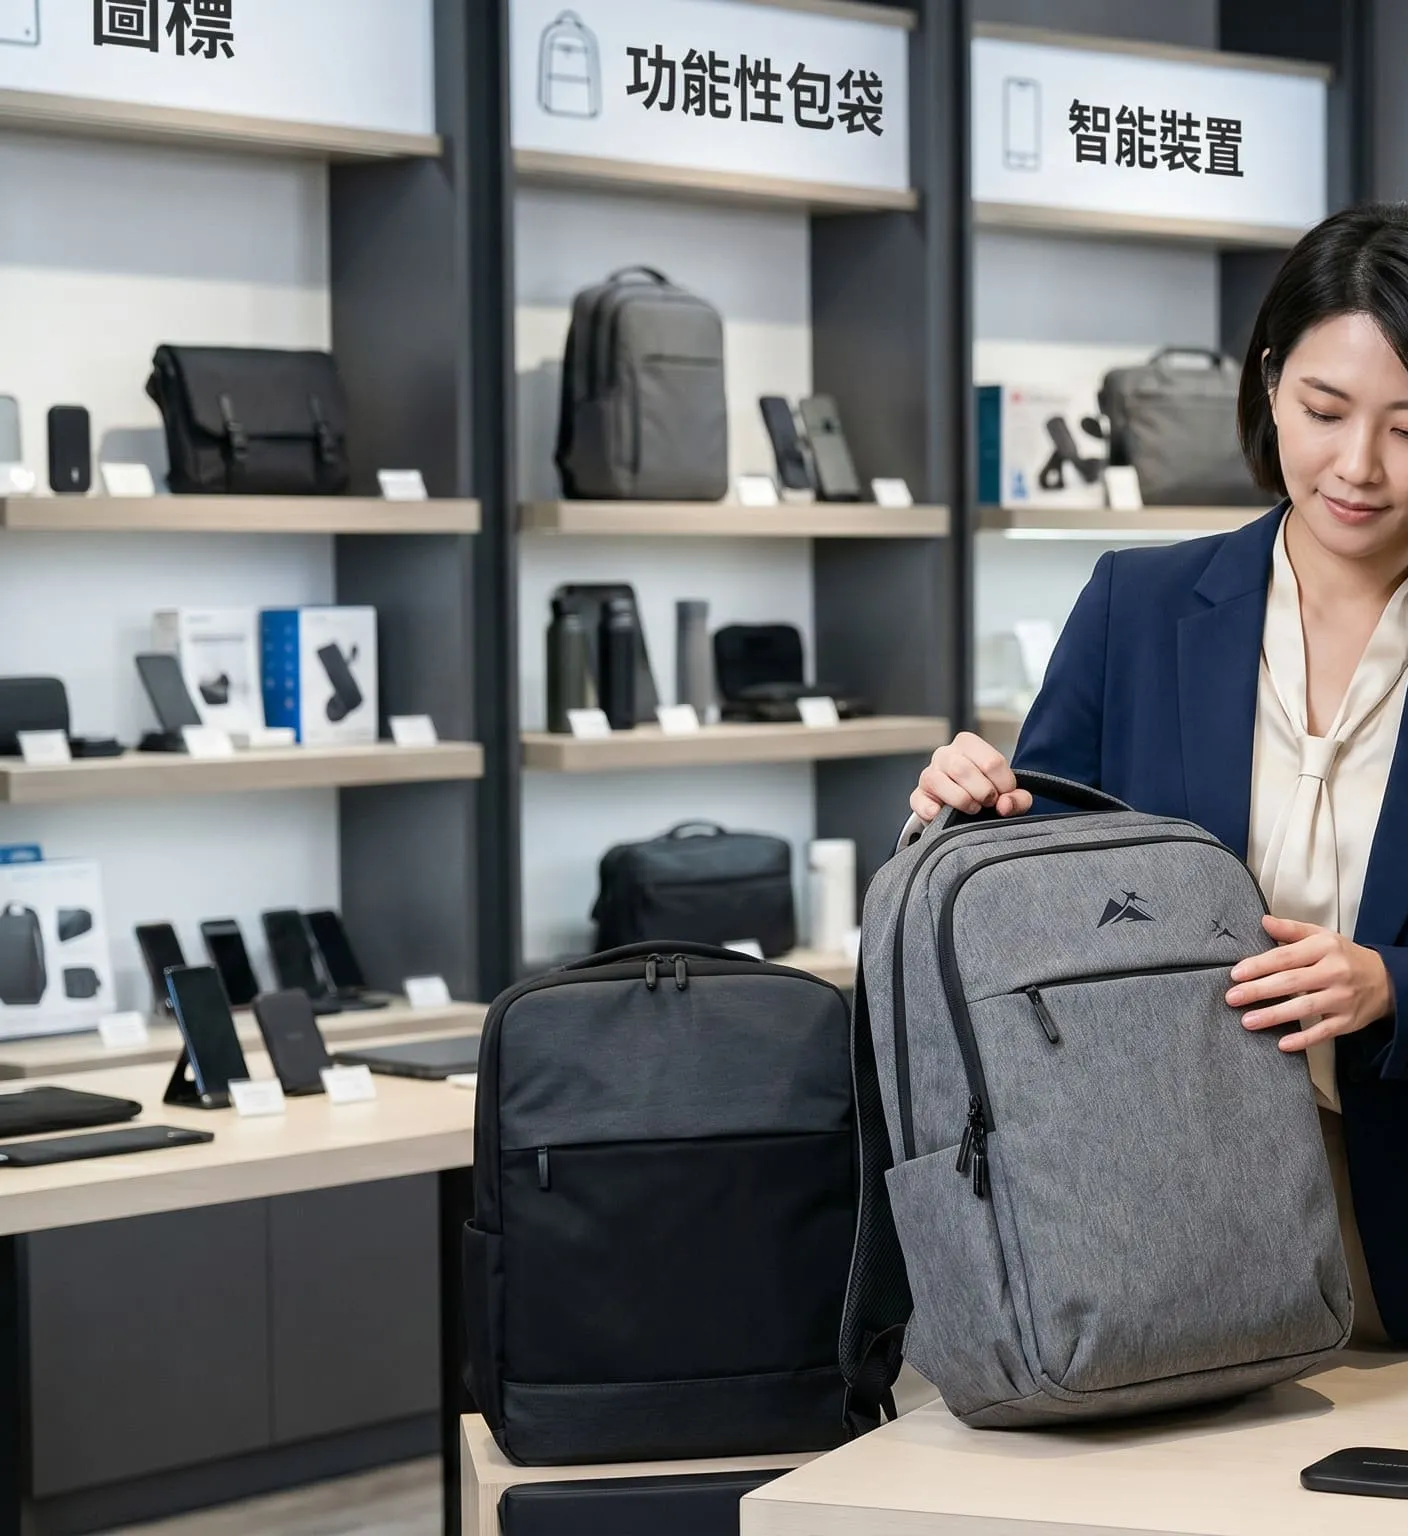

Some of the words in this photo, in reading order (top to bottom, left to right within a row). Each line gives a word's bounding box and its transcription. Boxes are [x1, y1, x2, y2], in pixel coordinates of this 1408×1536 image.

[93, 0, 235, 59] 圖標
[626, 44, 884, 137] 功能性包袋
[1068, 98, 1244, 178] 智能裝置
